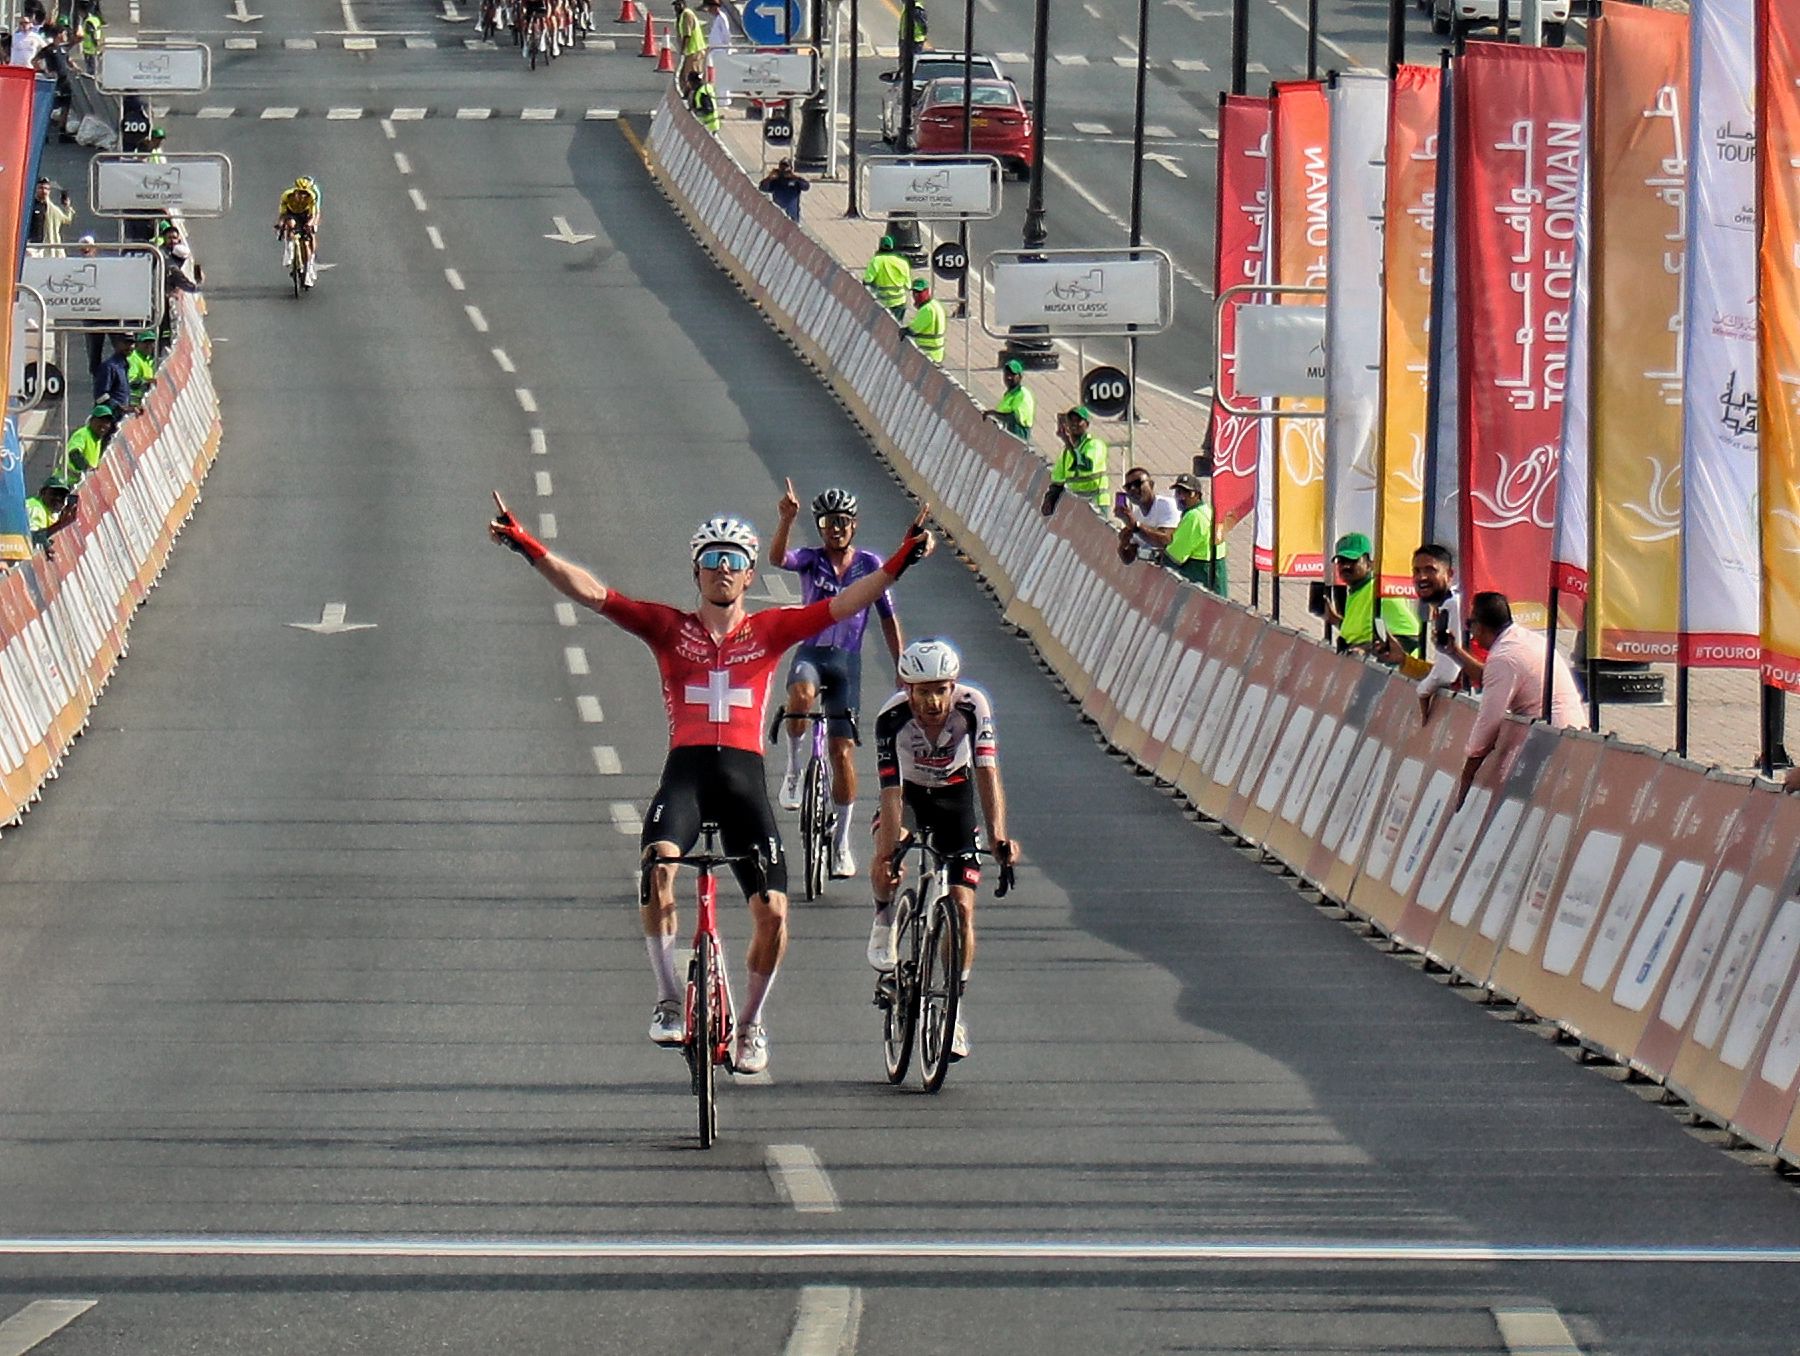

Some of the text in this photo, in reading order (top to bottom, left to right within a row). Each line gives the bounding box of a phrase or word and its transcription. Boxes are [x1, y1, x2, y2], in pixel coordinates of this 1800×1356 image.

[124, 122, 147, 132] 200
[767, 126, 790, 136] 200
[935, 254, 965, 268] 150
[1494, 120, 1542, 410] طواف عمان
[1543, 121, 1583, 411] TOUR OF OMAN
[1044, 303, 1076, 312] MUSCAT
[26, 380, 61, 395] 10
[1090, 381, 1124, 400] 100
[724, 649, 766, 666] Jayco
